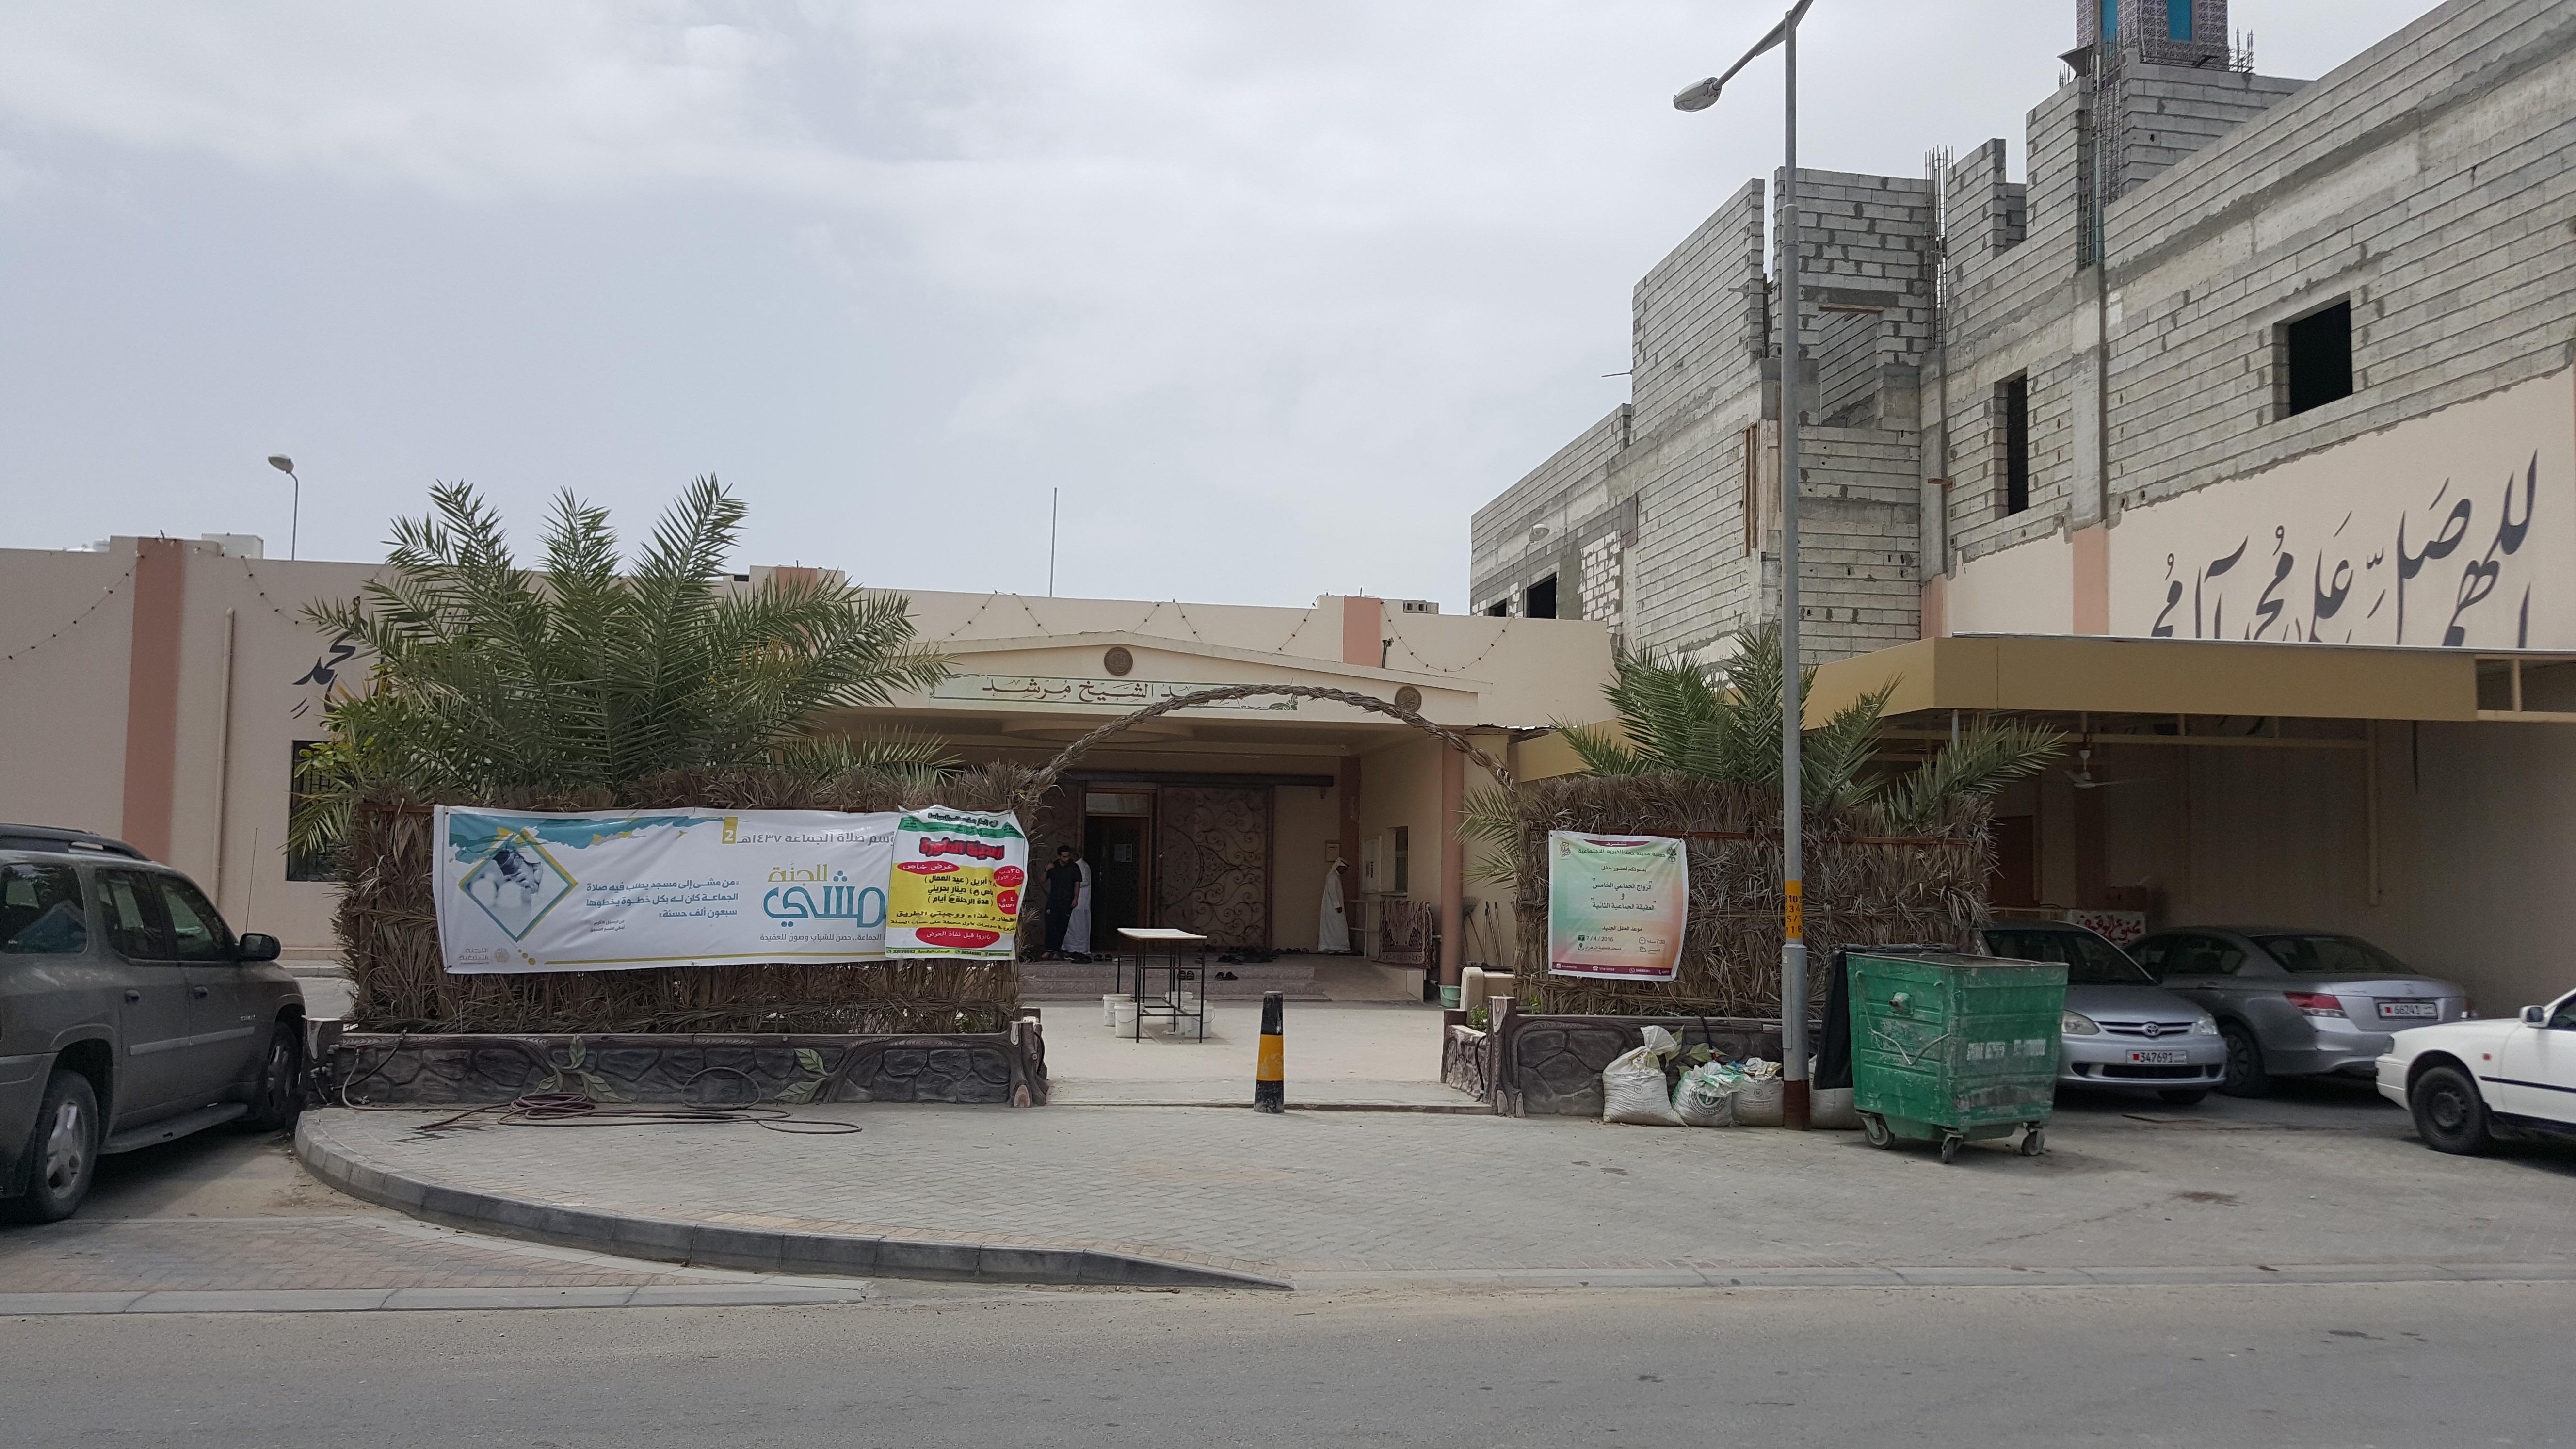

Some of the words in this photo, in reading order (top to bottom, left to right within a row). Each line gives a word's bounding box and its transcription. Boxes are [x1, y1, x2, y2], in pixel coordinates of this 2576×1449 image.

[724, 830, 733, 841] 2
[785, 833, 833, 845] الجماعة
[837, 833, 865, 843] صلاة
[586, 883, 607, 891] صلاة
[609, 882, 624, 893] فيه
[678, 880, 692, 889] إلى
[1614, 882, 1636, 891] الجماعي
[928, 885, 949, 895] بحريني
[981, 888, 994, 897] باص
[621, 896, 651, 906] خطوة
[652, 895, 669, 904] بكل
[685, 894, 701, 904] كان
[702, 893, 739, 902] الجماعة
[586, 898, 620, 908] يخطوها
[1611, 902, 1635, 911] الجماعية
[689, 907, 706, 917] ألف
[707, 909, 738, 918] سبعون
[760, 933, 787, 941] للعقيدة
[811, 933, 834, 942] للشباب
[2140, 1052, 2173, 1063] 347691
